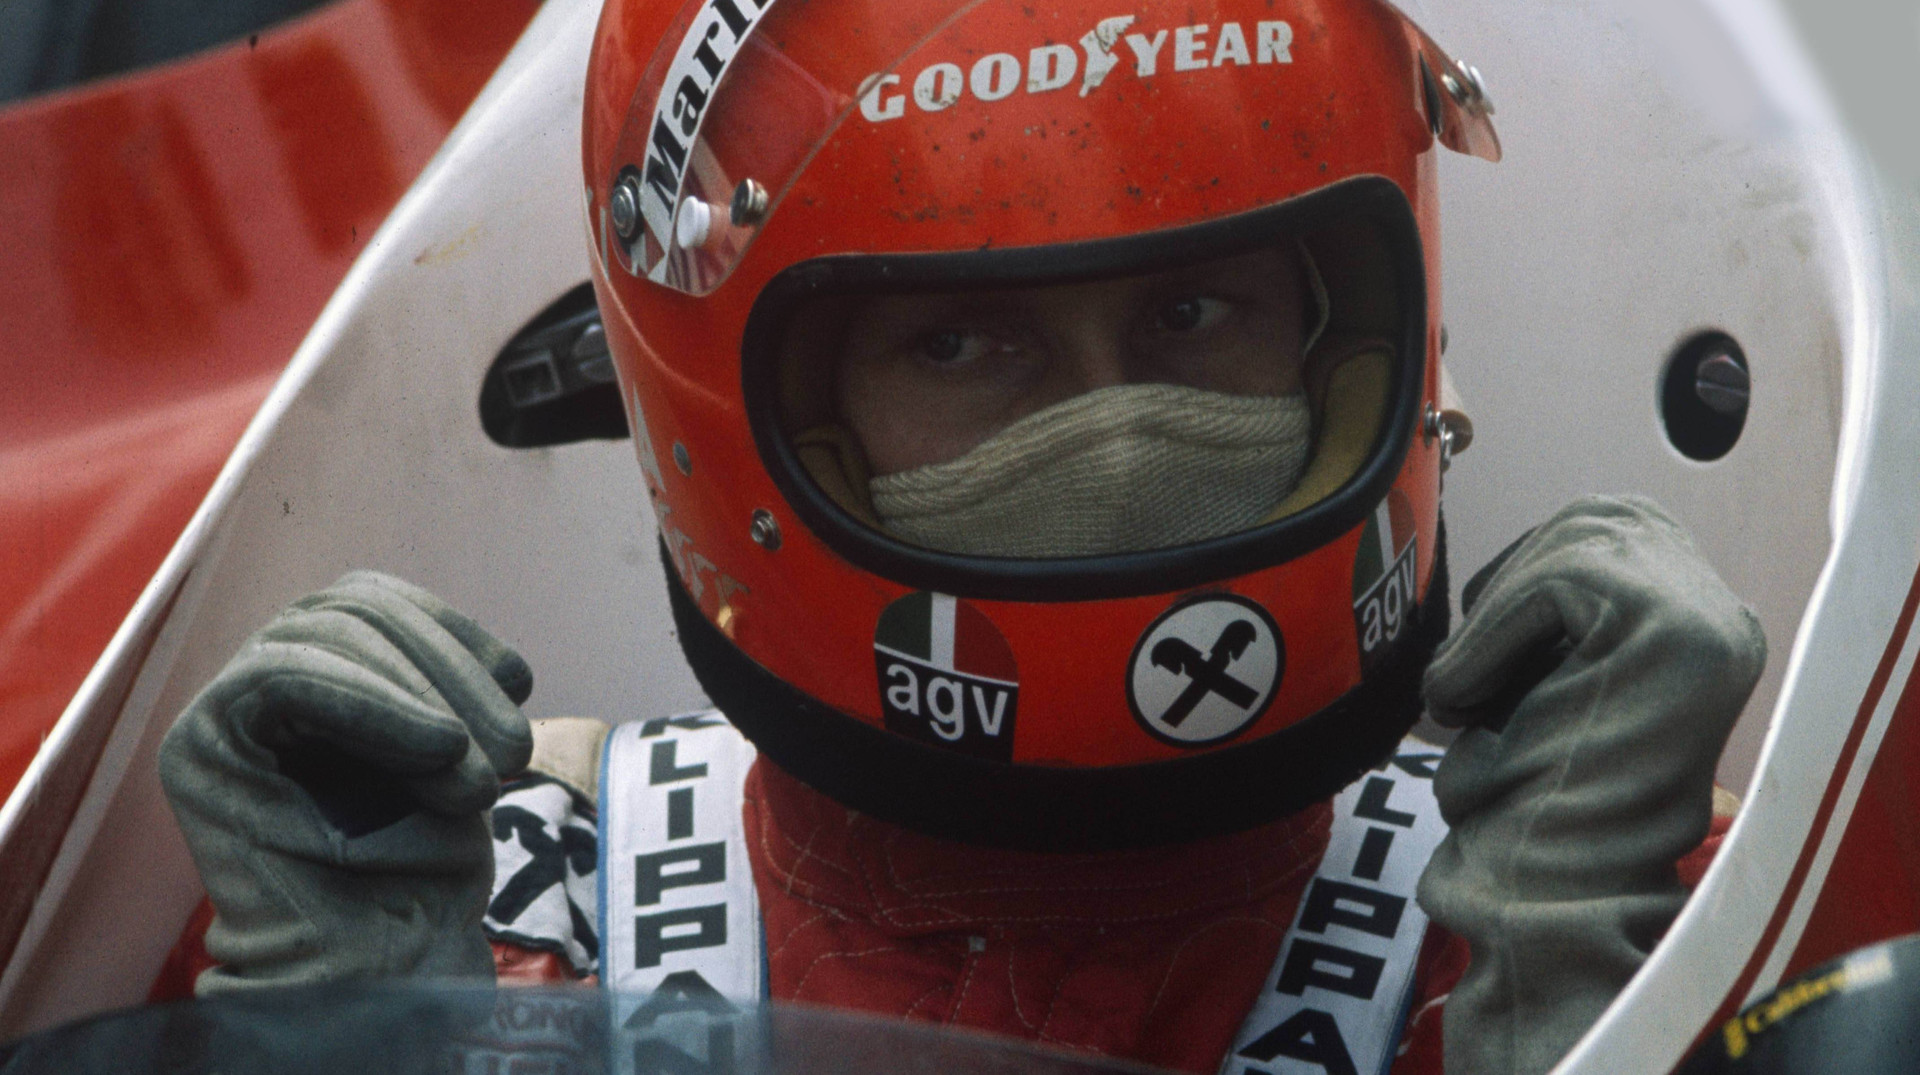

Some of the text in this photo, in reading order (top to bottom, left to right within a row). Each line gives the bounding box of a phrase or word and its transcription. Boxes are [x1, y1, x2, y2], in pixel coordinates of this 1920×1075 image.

[646, 0, 771, 220] Marl
[857, 18, 1293, 122] GOODYEAR
[1363, 545, 1415, 652] agv
[885, 663, 1009, 741] agv
[1237, 753, 1446, 1075] LIPPA
